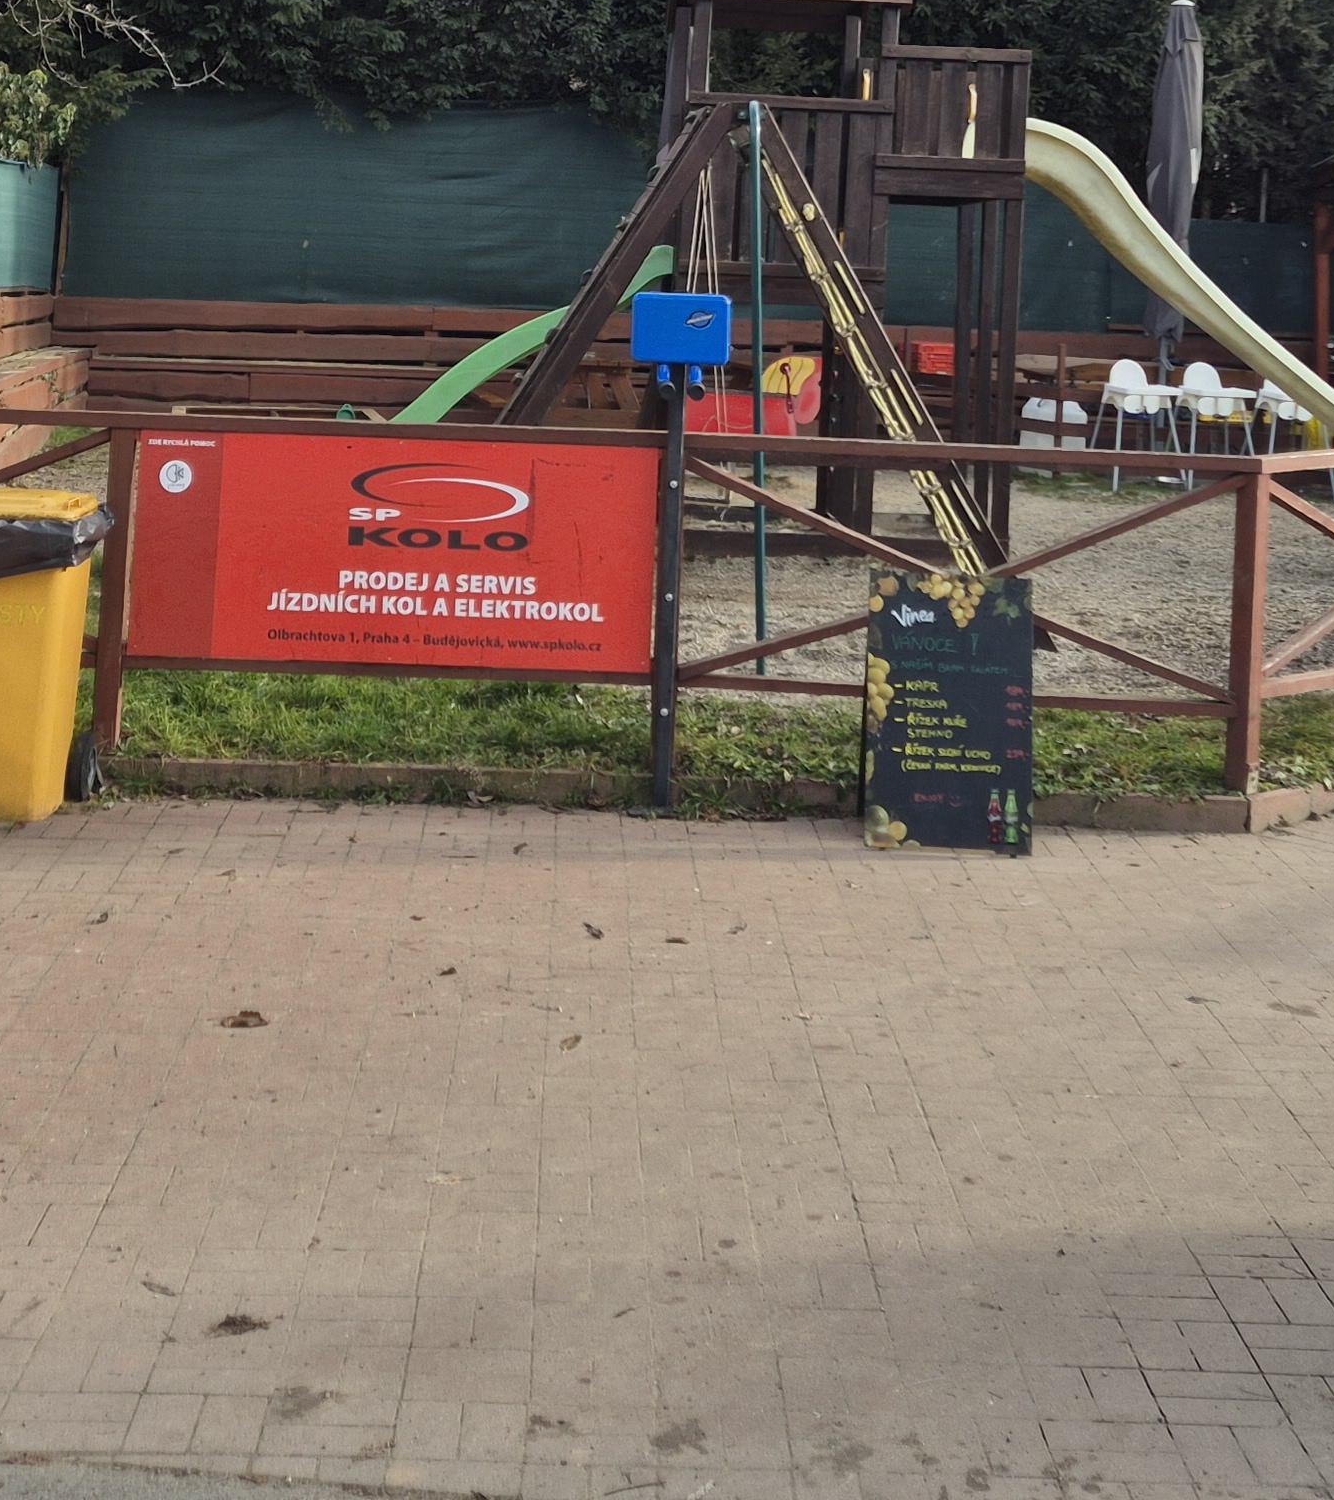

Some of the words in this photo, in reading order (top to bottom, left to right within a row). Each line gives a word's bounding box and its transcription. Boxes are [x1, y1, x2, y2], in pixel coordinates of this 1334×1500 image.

[349, 507, 402, 521] SP
[348, 526, 528, 551] KOLO
[338, 570, 429, 591] PRODEJ
[433, 573, 450, 592] A
[455, 574, 537, 595] SERVIS
[266, 587, 376, 614] JÍZDNÍCH
[382, 595, 428, 616] KOL
[432, 597, 449, 617] A
[454, 598, 605, 623] ELEKTROKOL
[891, 603, 937, 627] Vinea
[267, 629, 346, 643] Olbrachtova
[363, 632, 399, 645] Praha
[402, 633, 411, 644] 4
[508, 637, 603, 652] www.spkolo.cz
